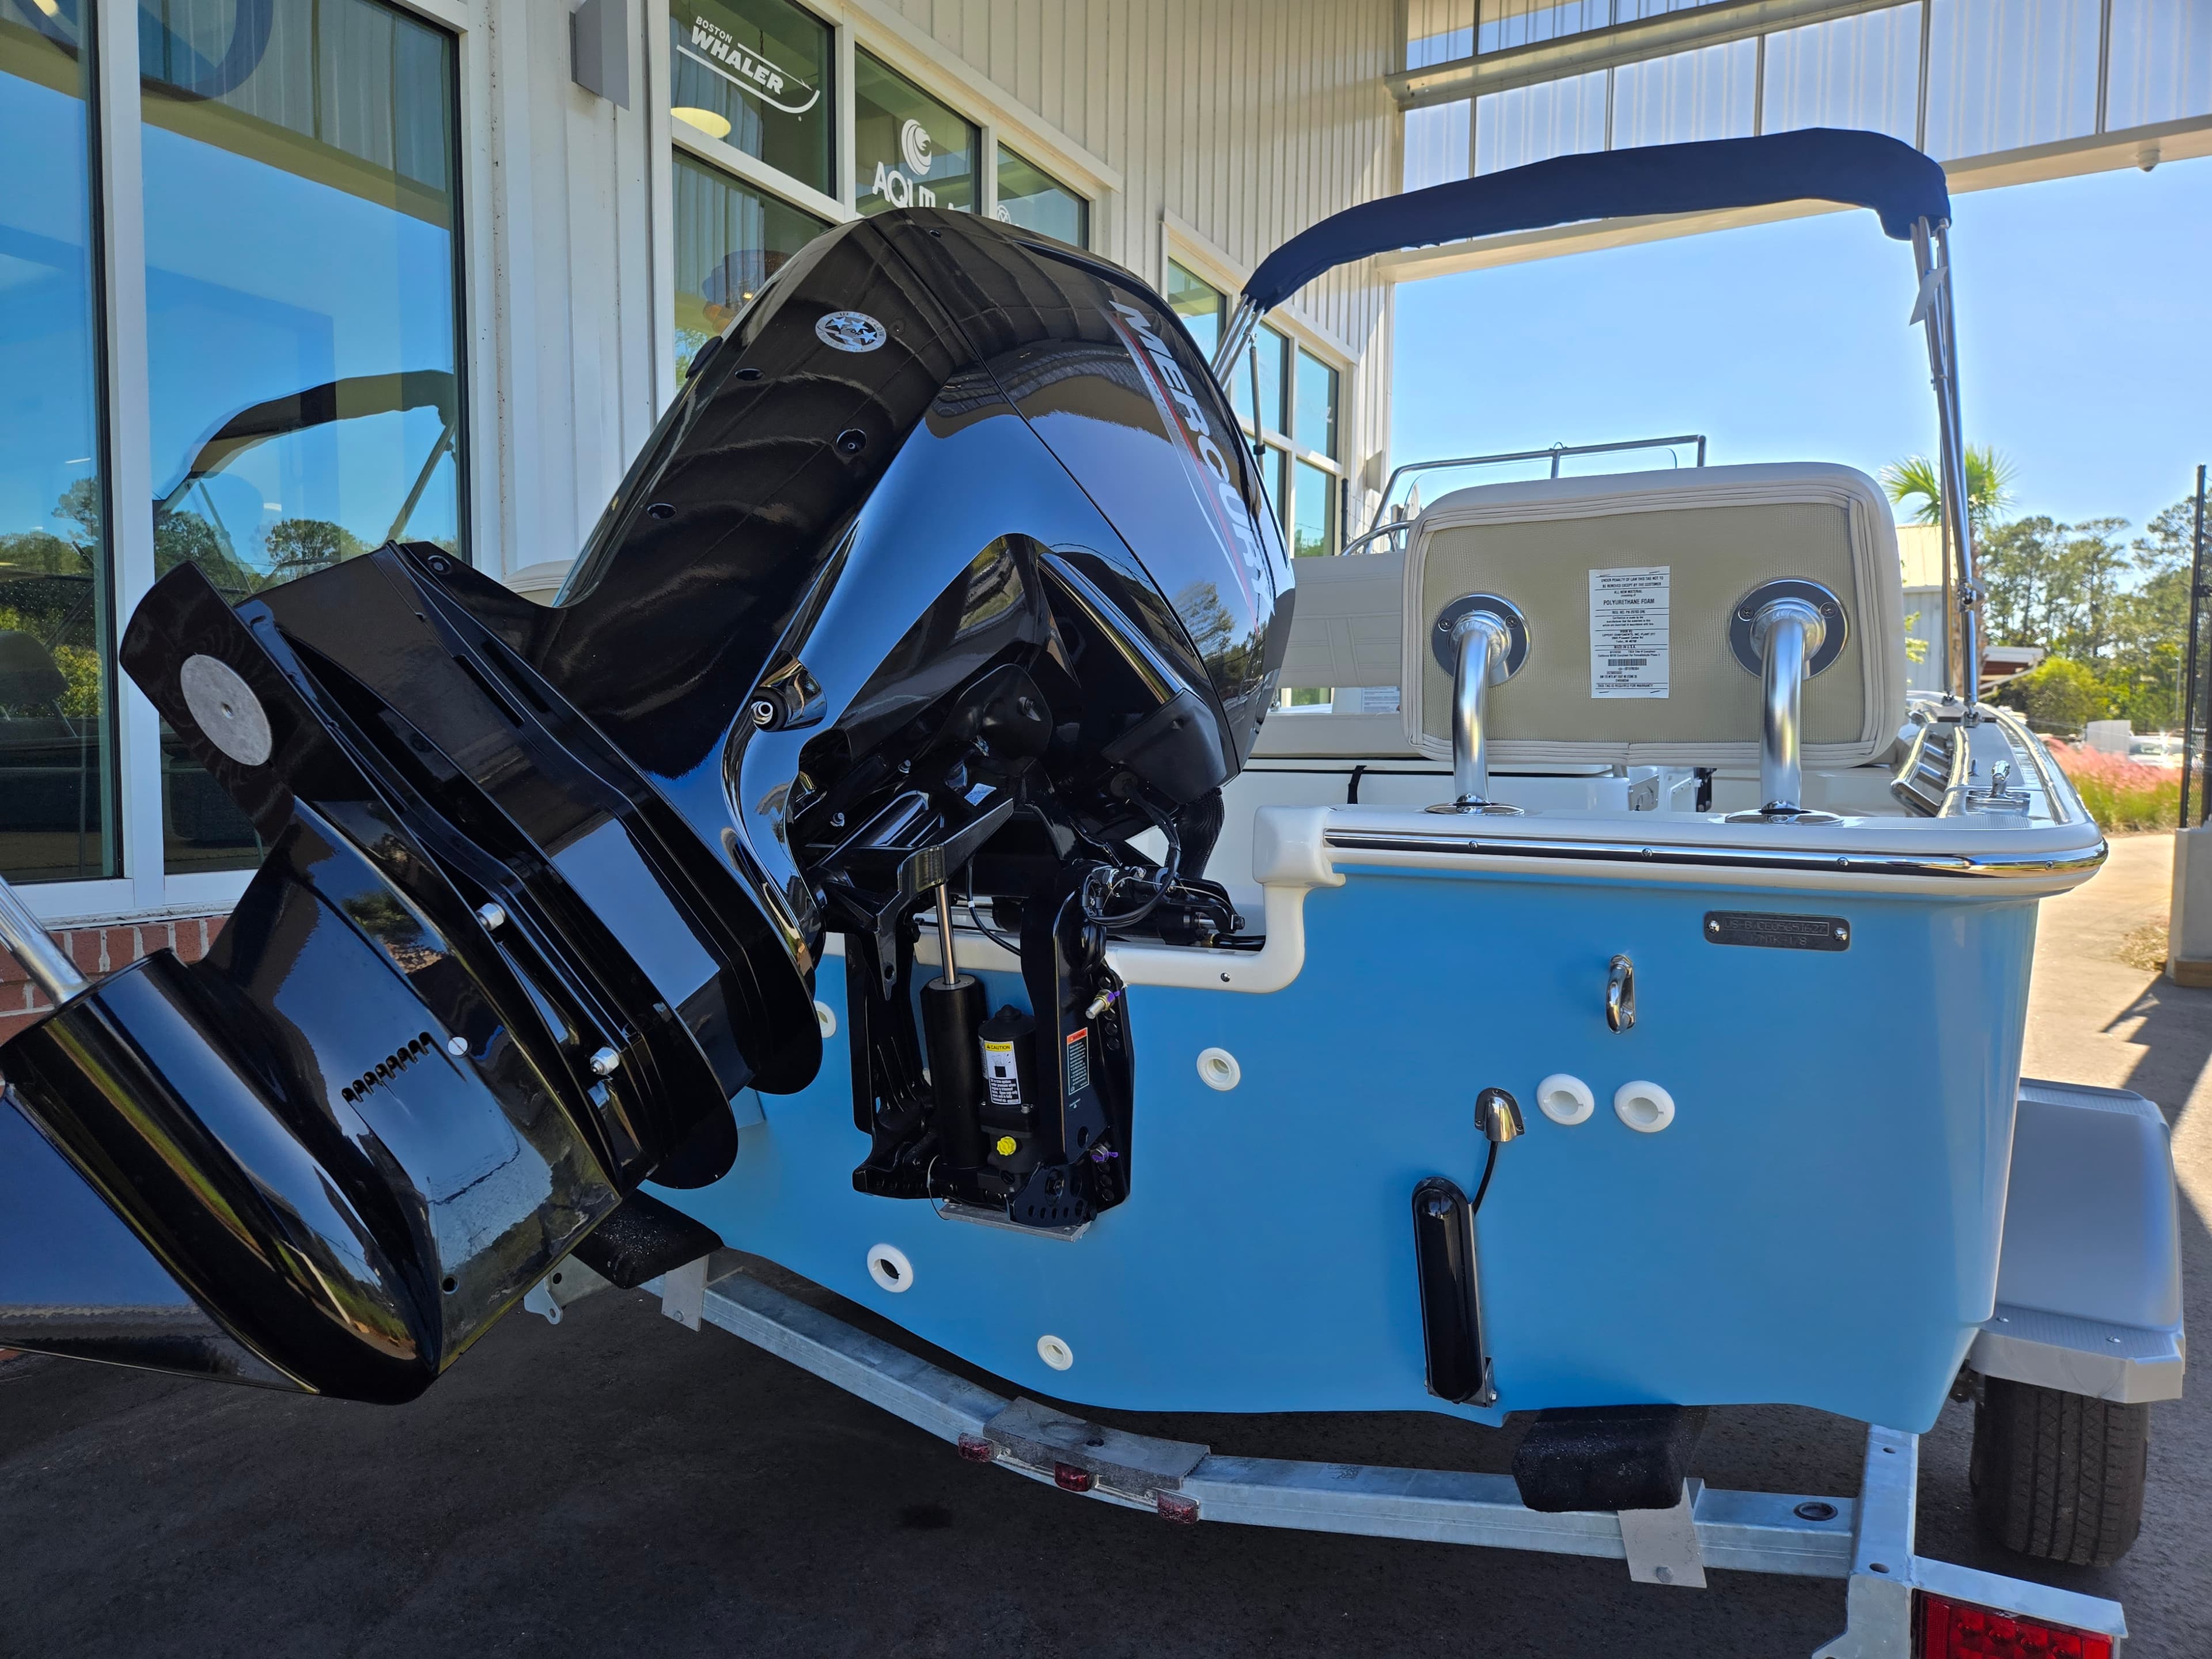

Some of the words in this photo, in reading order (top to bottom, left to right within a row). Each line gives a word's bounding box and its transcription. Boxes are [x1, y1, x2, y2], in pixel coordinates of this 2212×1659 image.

[691, 25, 784, 95] WHALER
[696, 16, 733, 43] BOSTON
[1109, 300, 1276, 616] MERCURY
